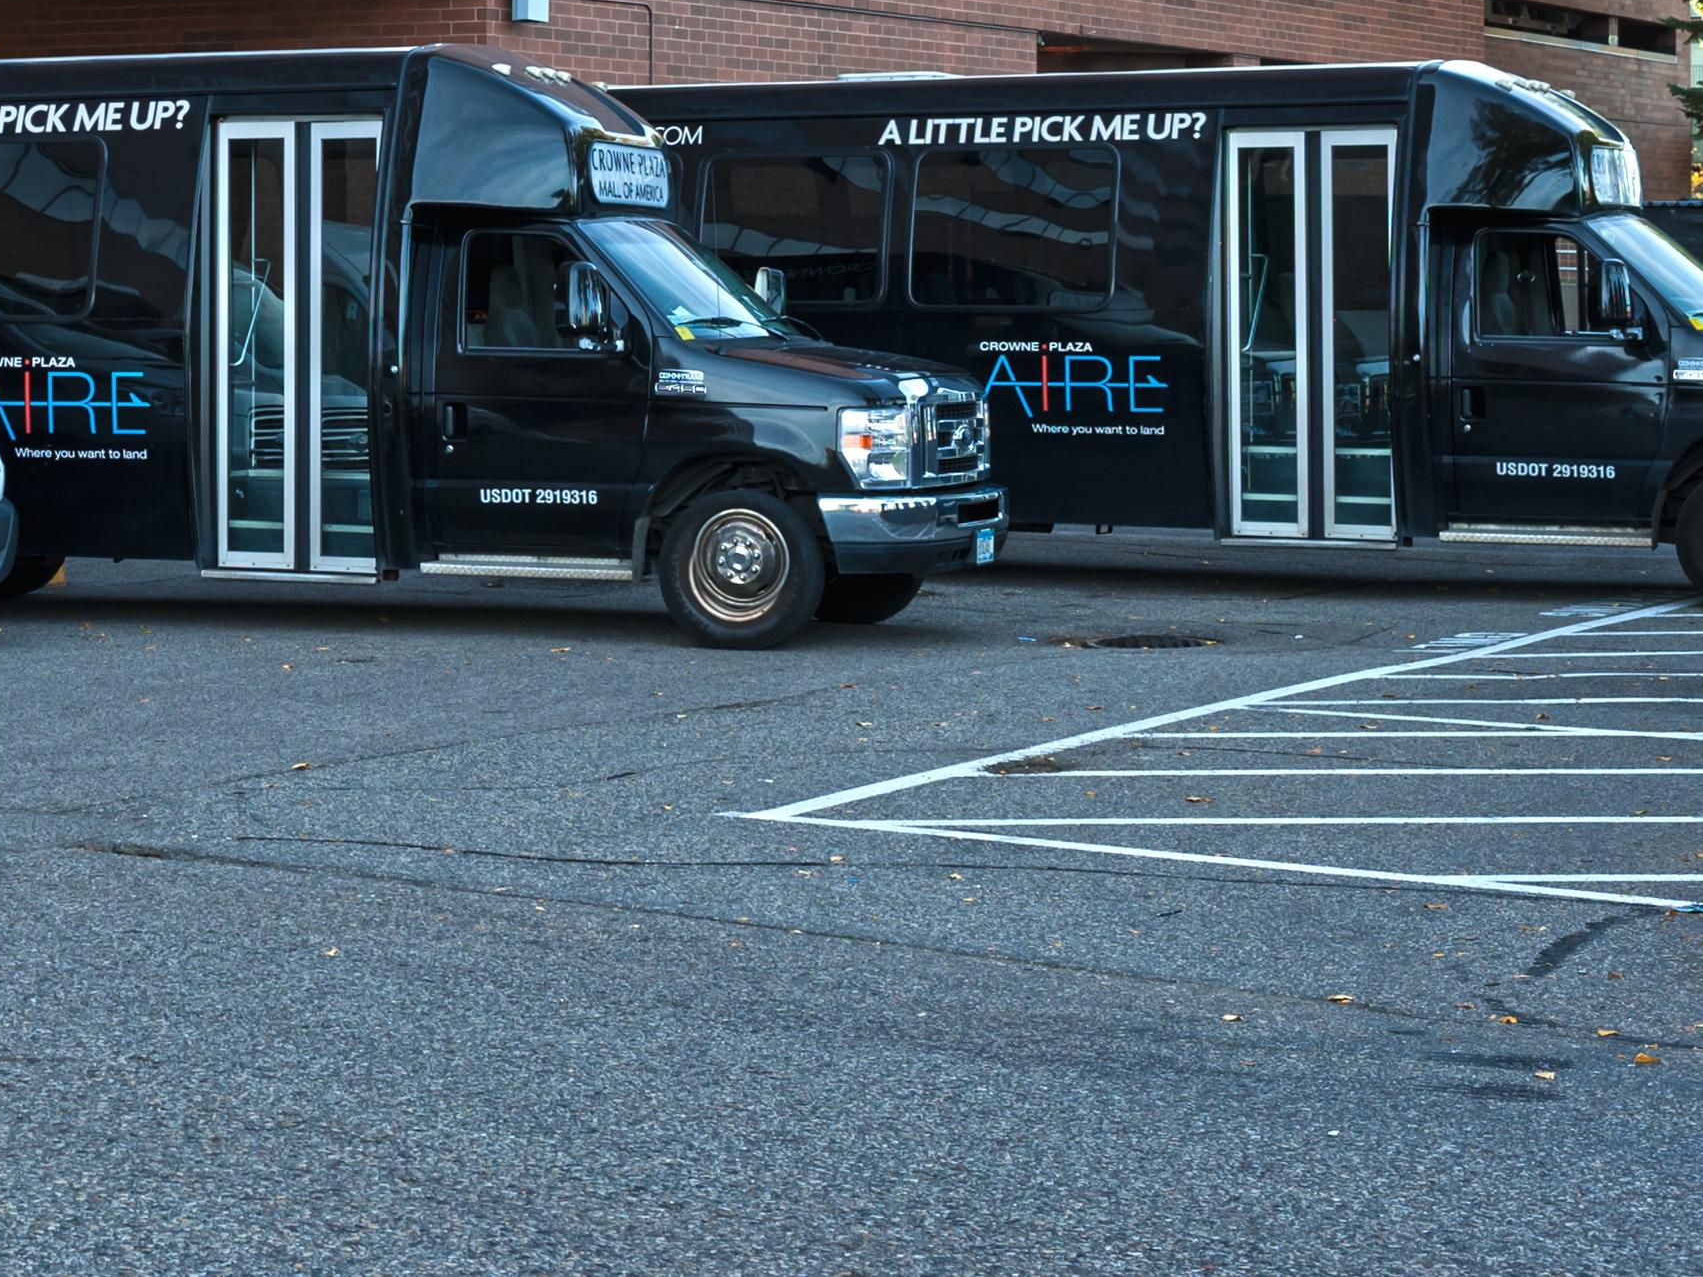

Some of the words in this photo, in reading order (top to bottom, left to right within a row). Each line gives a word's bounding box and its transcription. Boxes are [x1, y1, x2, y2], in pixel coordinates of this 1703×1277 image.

[72, 101, 125, 133] ME
[128, 99, 191, 130] UP?
[877, 119, 902, 146] A
[907, 117, 1009, 145] LITTLE
[1012, 115, 1087, 143] PICK
[1089, 113, 1142, 141] ME
[1145, 112, 1208, 140] UP?
[591, 148, 636, 175] CROWNE
[637, 153, 666, 179] PLAZA
[622, 182, 634, 200] OF
[635, 183, 665, 203] AMERICA
[979, 341, 1040, 352] CROWNE
[1048, 341, 1093, 352] PLAZA
[31, 356, 76, 368] PLAZA
[982, 354, 1168, 418] AIRE
[1032, 423, 1069, 434] Where
[1071, 425, 1093, 436] you
[1095, 424, 1123, 435] want
[1125, 424, 1138, 435] to
[1140, 425, 1165, 435] land
[14, 447, 52, 458] Where
[54, 449, 76, 461] you
[77, 448, 106, 459] want
[109, 448, 121, 459] to
[122, 448, 148, 460] land
[1496, 462, 1549, 477] USDOT
[1552, 464, 1616, 479] 2919316
[480, 488, 532, 504] USDOT
[535, 489, 598, 505] 2919316
